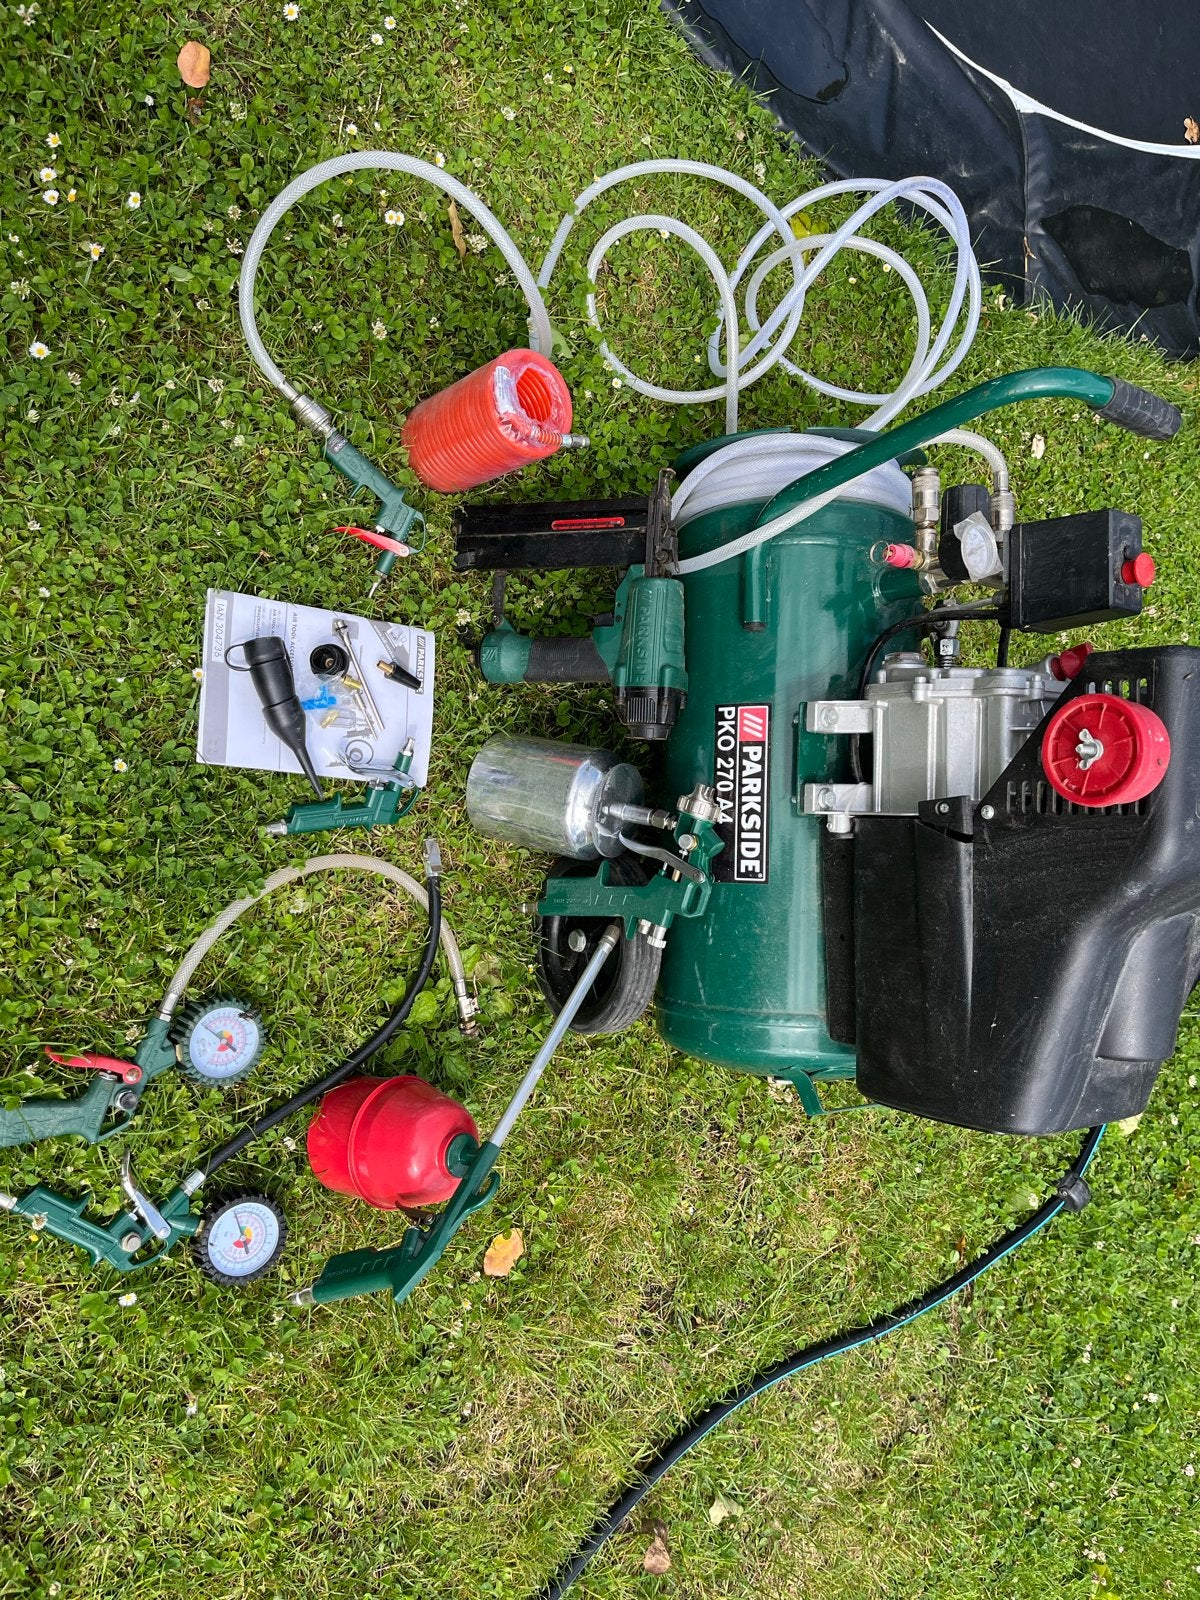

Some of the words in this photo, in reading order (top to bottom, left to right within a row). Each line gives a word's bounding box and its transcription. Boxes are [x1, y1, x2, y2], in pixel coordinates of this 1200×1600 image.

[215, 603, 225, 621] IAN
[214, 622, 224, 658] 304736
[632, 606, 651, 683] PARKSIDE
[717, 706, 735, 752] PKO
[716, 757, 735, 792] 270
[716, 797, 734, 825] A4
[740, 745, 763, 873] PARKSIDE
